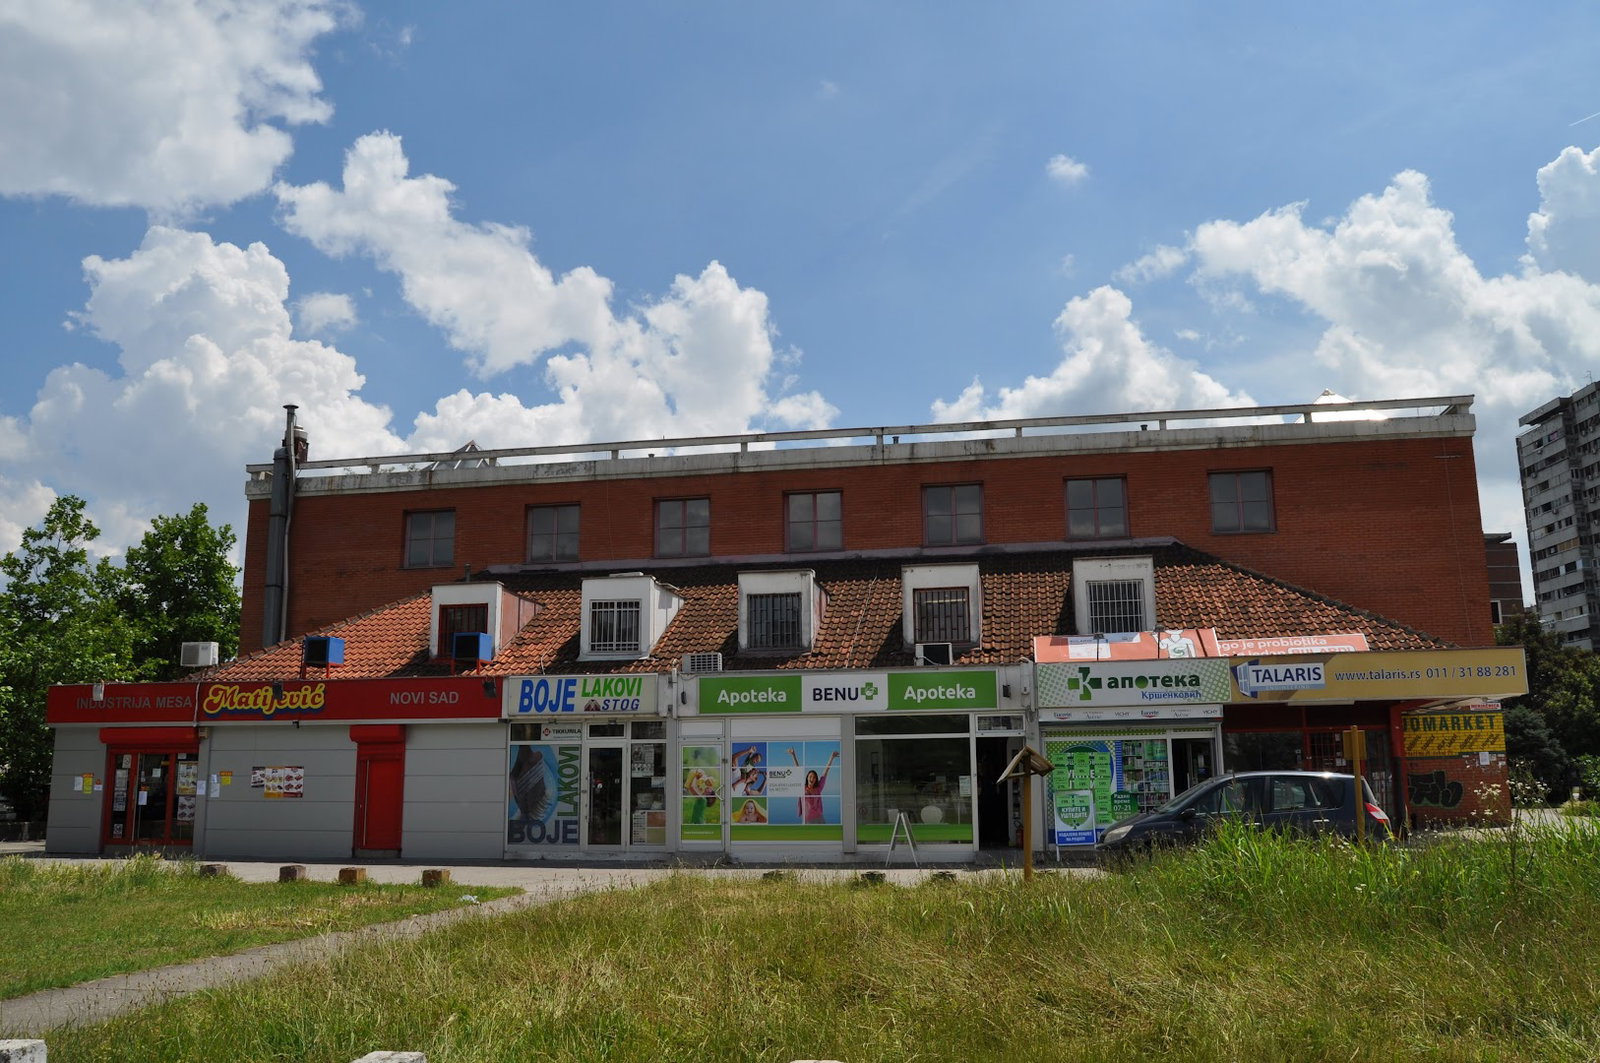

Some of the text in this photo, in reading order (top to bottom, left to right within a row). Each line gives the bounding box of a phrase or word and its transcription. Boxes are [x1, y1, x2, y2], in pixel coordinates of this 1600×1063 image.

[1258, 636, 1328, 649] probiotika
[1252, 667, 1322, 683] TALARIS
[1334, 668, 1421, 681] www.talaris.rs
[1426, 667, 1448, 679] 011
[1459, 667, 1474, 678] 31
[1477, 667, 1492, 678] 88
[1495, 665, 1517, 677] 281
[1107, 673, 1201, 690] апотека
[203, 682, 326, 715] Matijević
[390, 691, 460, 705] NOVI SAD
[518, 677, 643, 713] BOJE LAKOVI
[717, 687, 787, 705] Apoteka
[812, 686, 859, 702] BENU
[904, 683, 976, 703] Apoteka
[76, 695, 192, 710] INDUSTRIJA MESA
[601, 698, 640, 711] STOG
[557, 745, 579, 817] LAKOVI
[508, 819, 579, 844] BOJE
